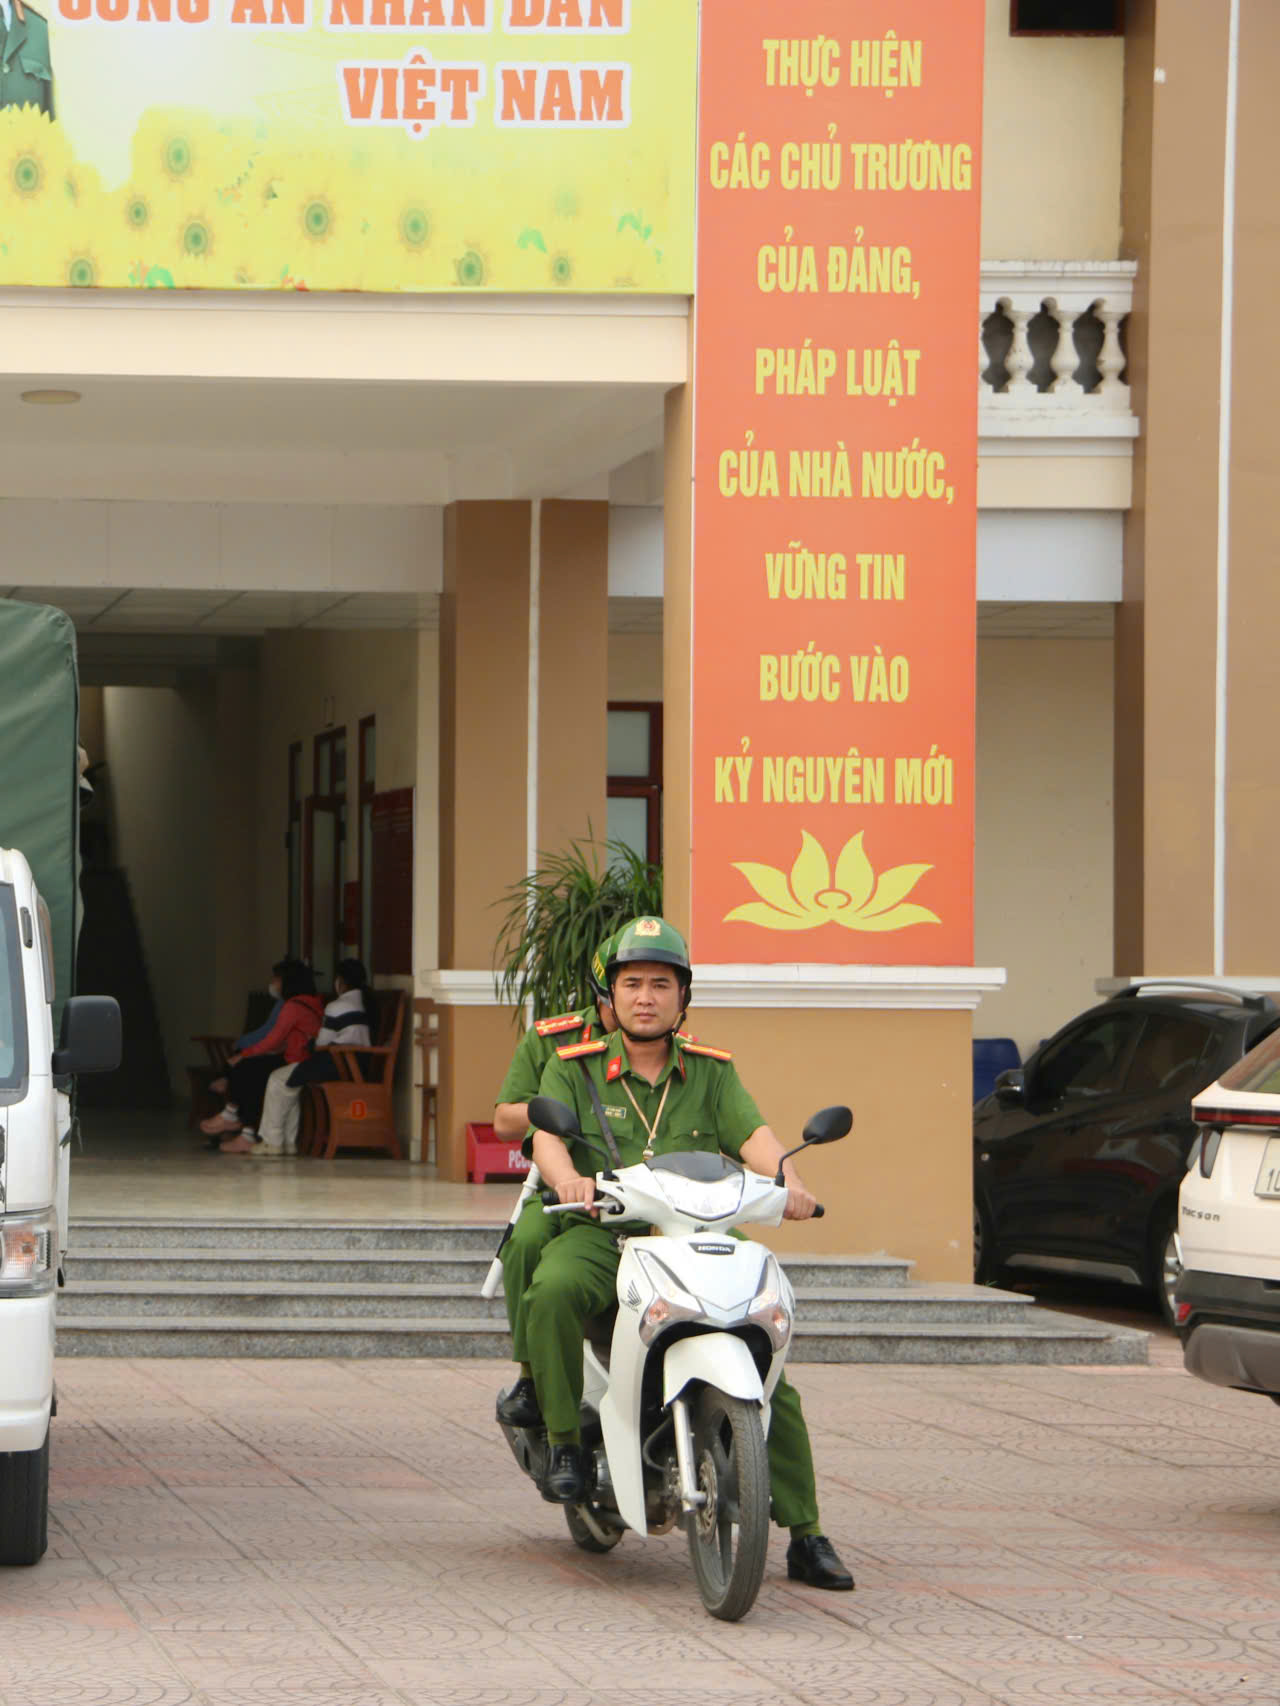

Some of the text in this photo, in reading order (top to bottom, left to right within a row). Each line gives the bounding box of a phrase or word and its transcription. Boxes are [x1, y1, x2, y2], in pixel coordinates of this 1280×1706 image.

[343, 54, 625, 133] VIỆT NAM
[763, 30, 923, 98] THỰC HIỆN
[710, 123, 972, 191] CÁC CHỦ TRƯƠNG
[757, 225, 920, 300] CỦA ĐẢNG,
[755, 339, 921, 406] PHÁP LUẬT
[719, 430, 954, 504] CỦA NHÀ NƯỚC,
[765, 541, 905, 600] VỮNG TIN
[760, 641, 909, 702] BƯỚC VÀO
[714, 736, 953, 804] KỶ NGUYÊN MỚI
[697, 1245, 732, 1253] HONDA
